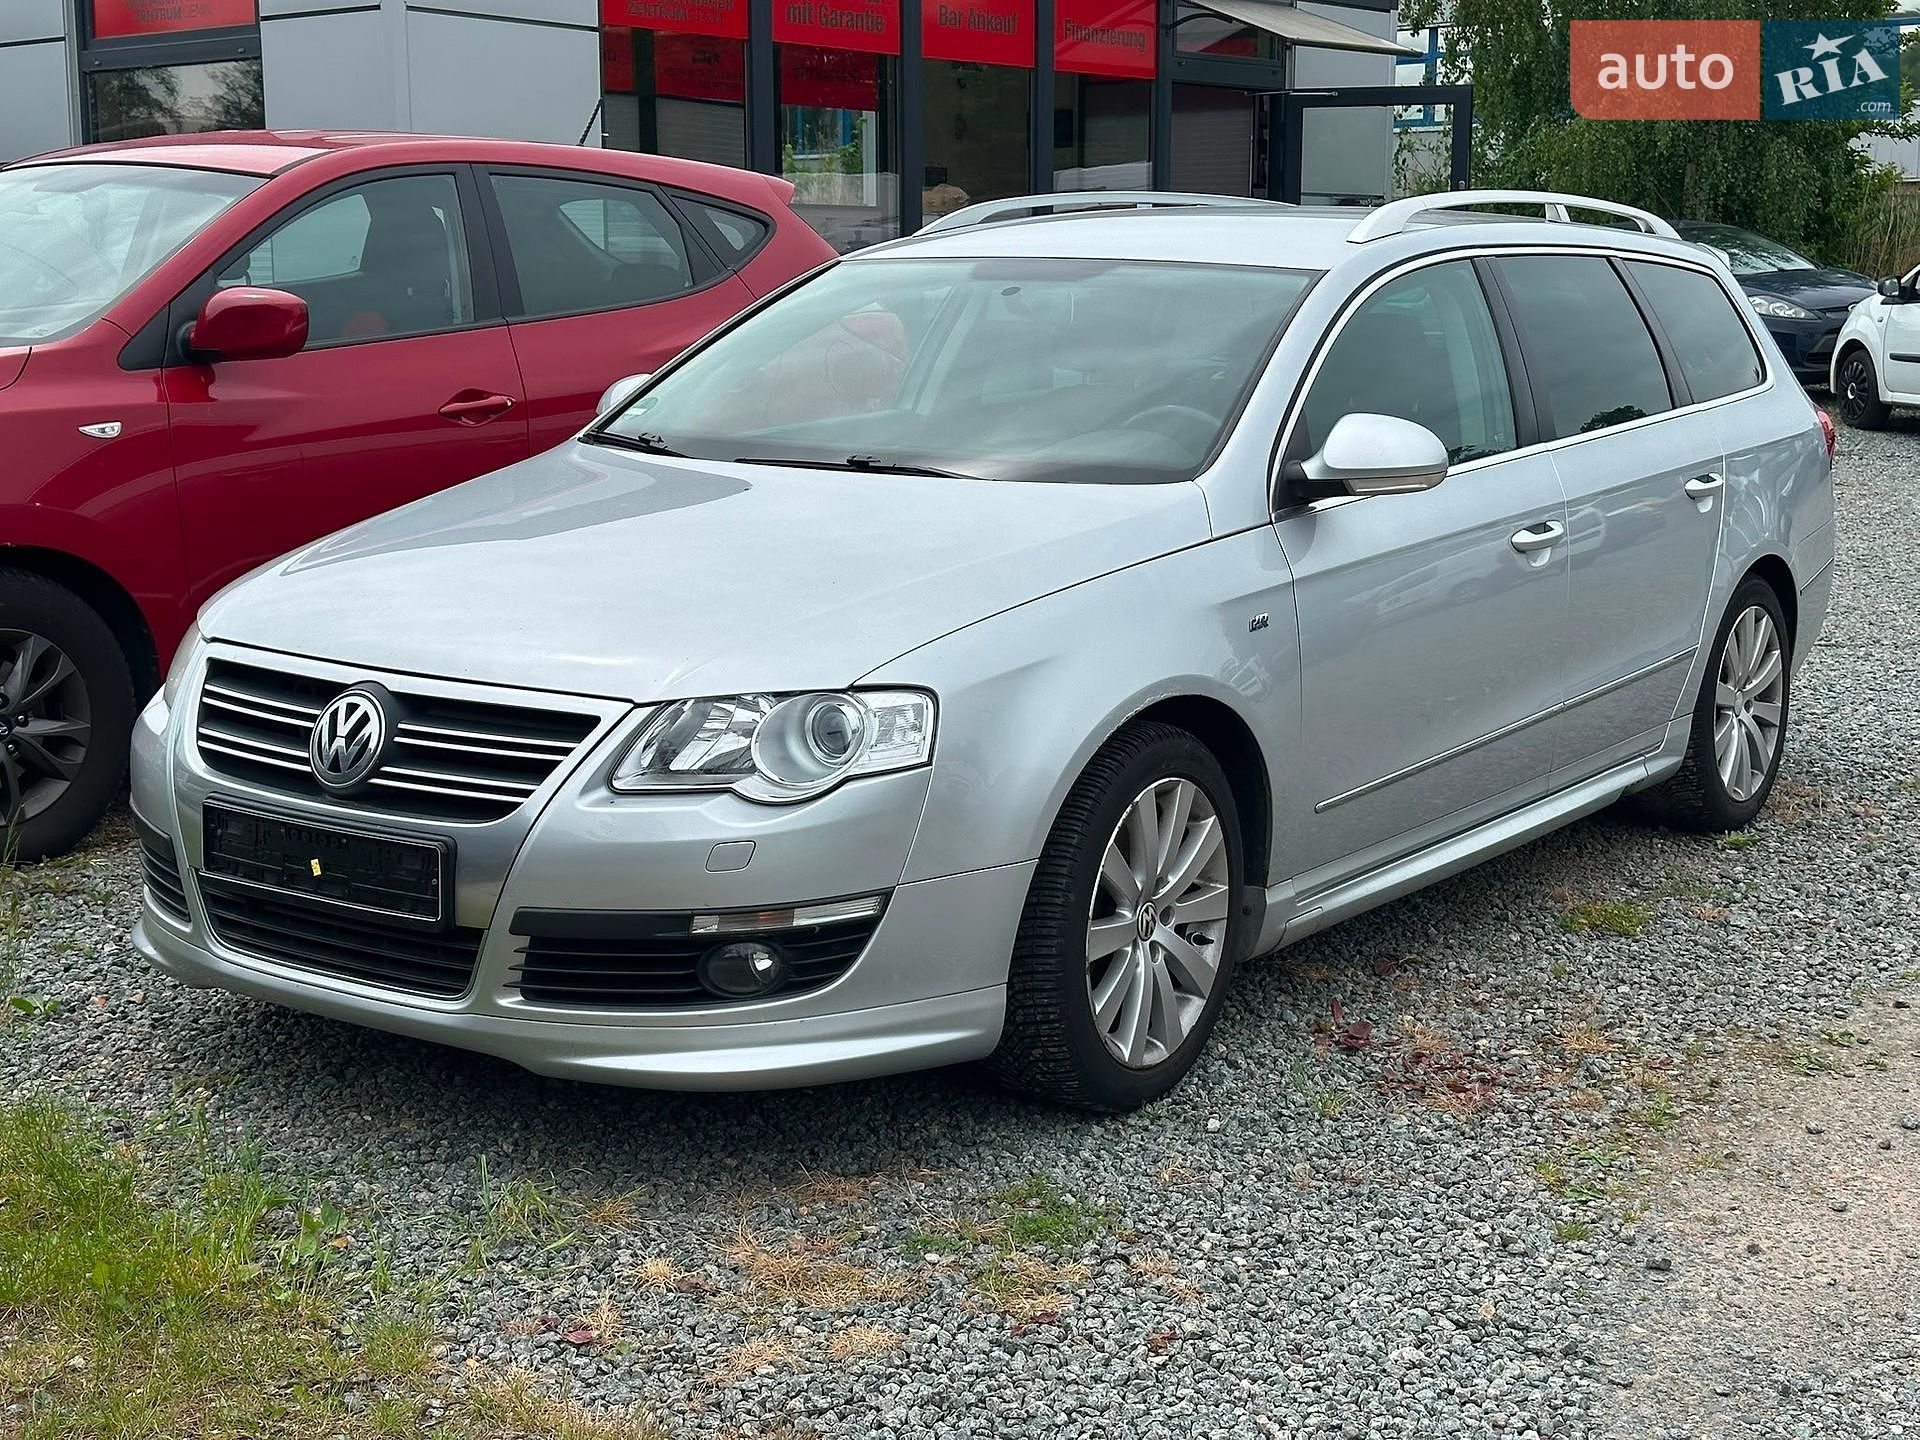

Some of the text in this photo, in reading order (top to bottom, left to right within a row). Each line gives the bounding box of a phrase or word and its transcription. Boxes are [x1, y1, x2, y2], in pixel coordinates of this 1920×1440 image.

[786, 2, 884, 33] mit Garantie
[939, 4, 1017, 34] Bar Ankauf
[1063, 19, 1146, 54] Finanzierung
